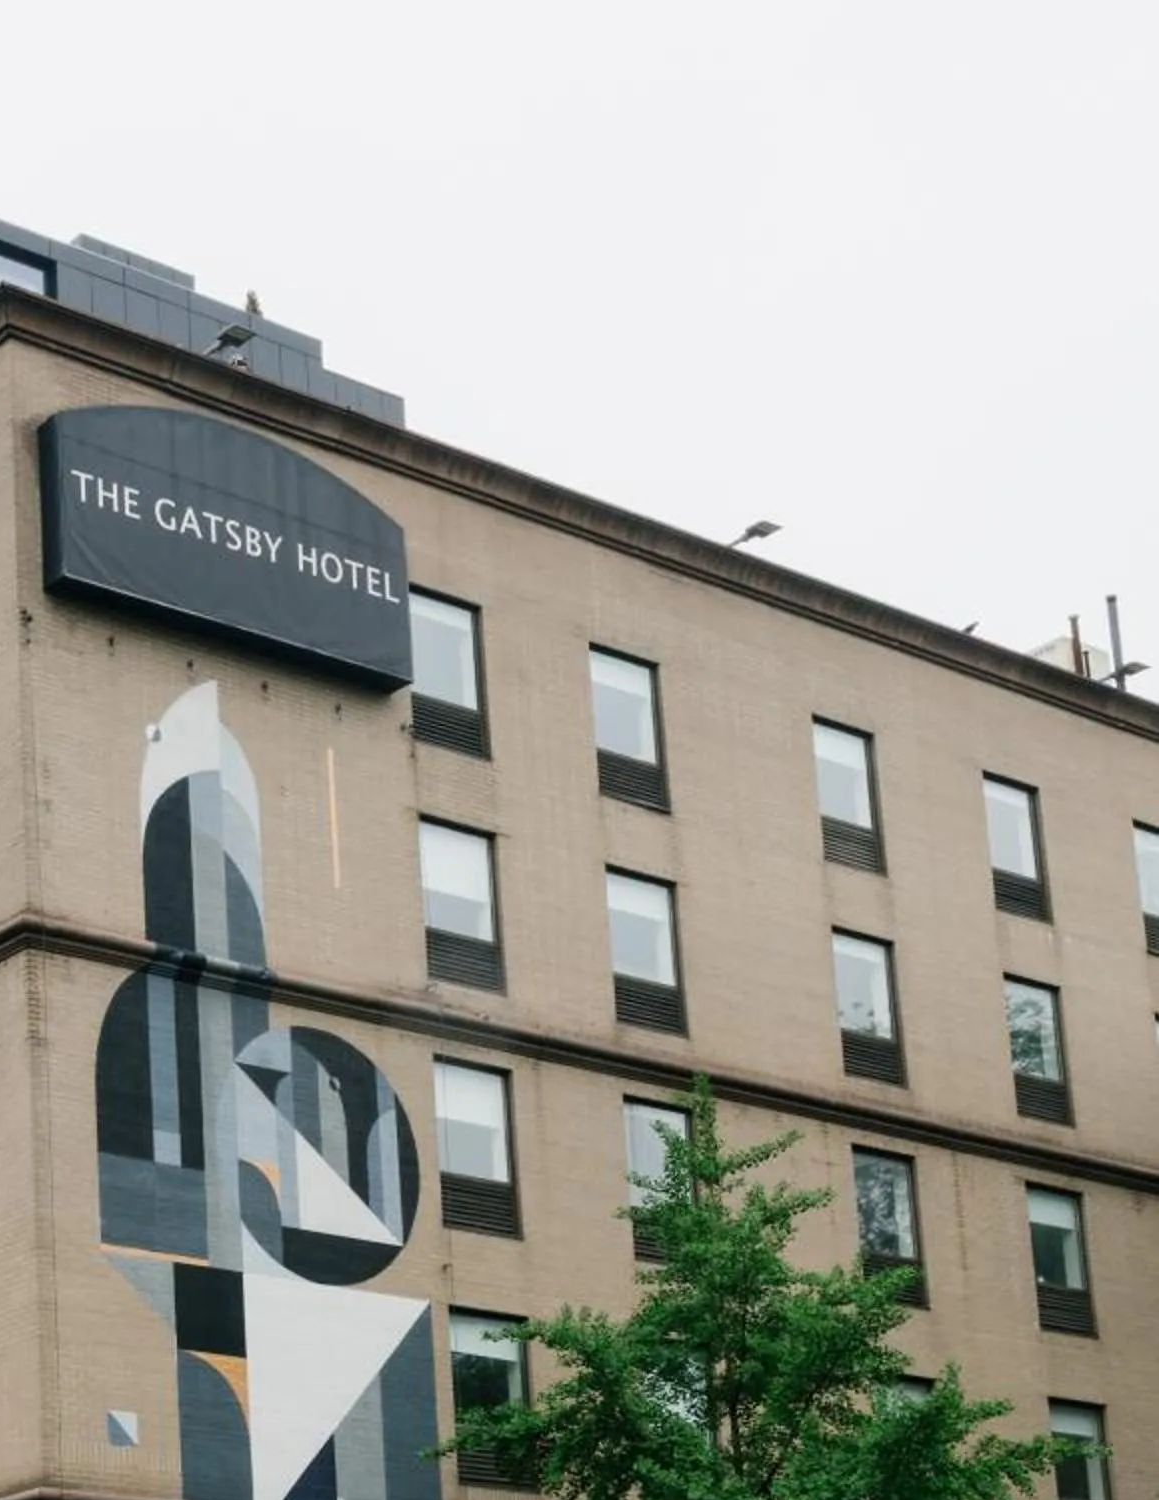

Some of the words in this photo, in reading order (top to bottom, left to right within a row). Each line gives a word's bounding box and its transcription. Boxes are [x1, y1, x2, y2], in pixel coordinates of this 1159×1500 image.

[70, 469, 141, 520] THE
[154, 497, 282, 563] GATSBY
[297, 543, 401, 604] HOTEL
